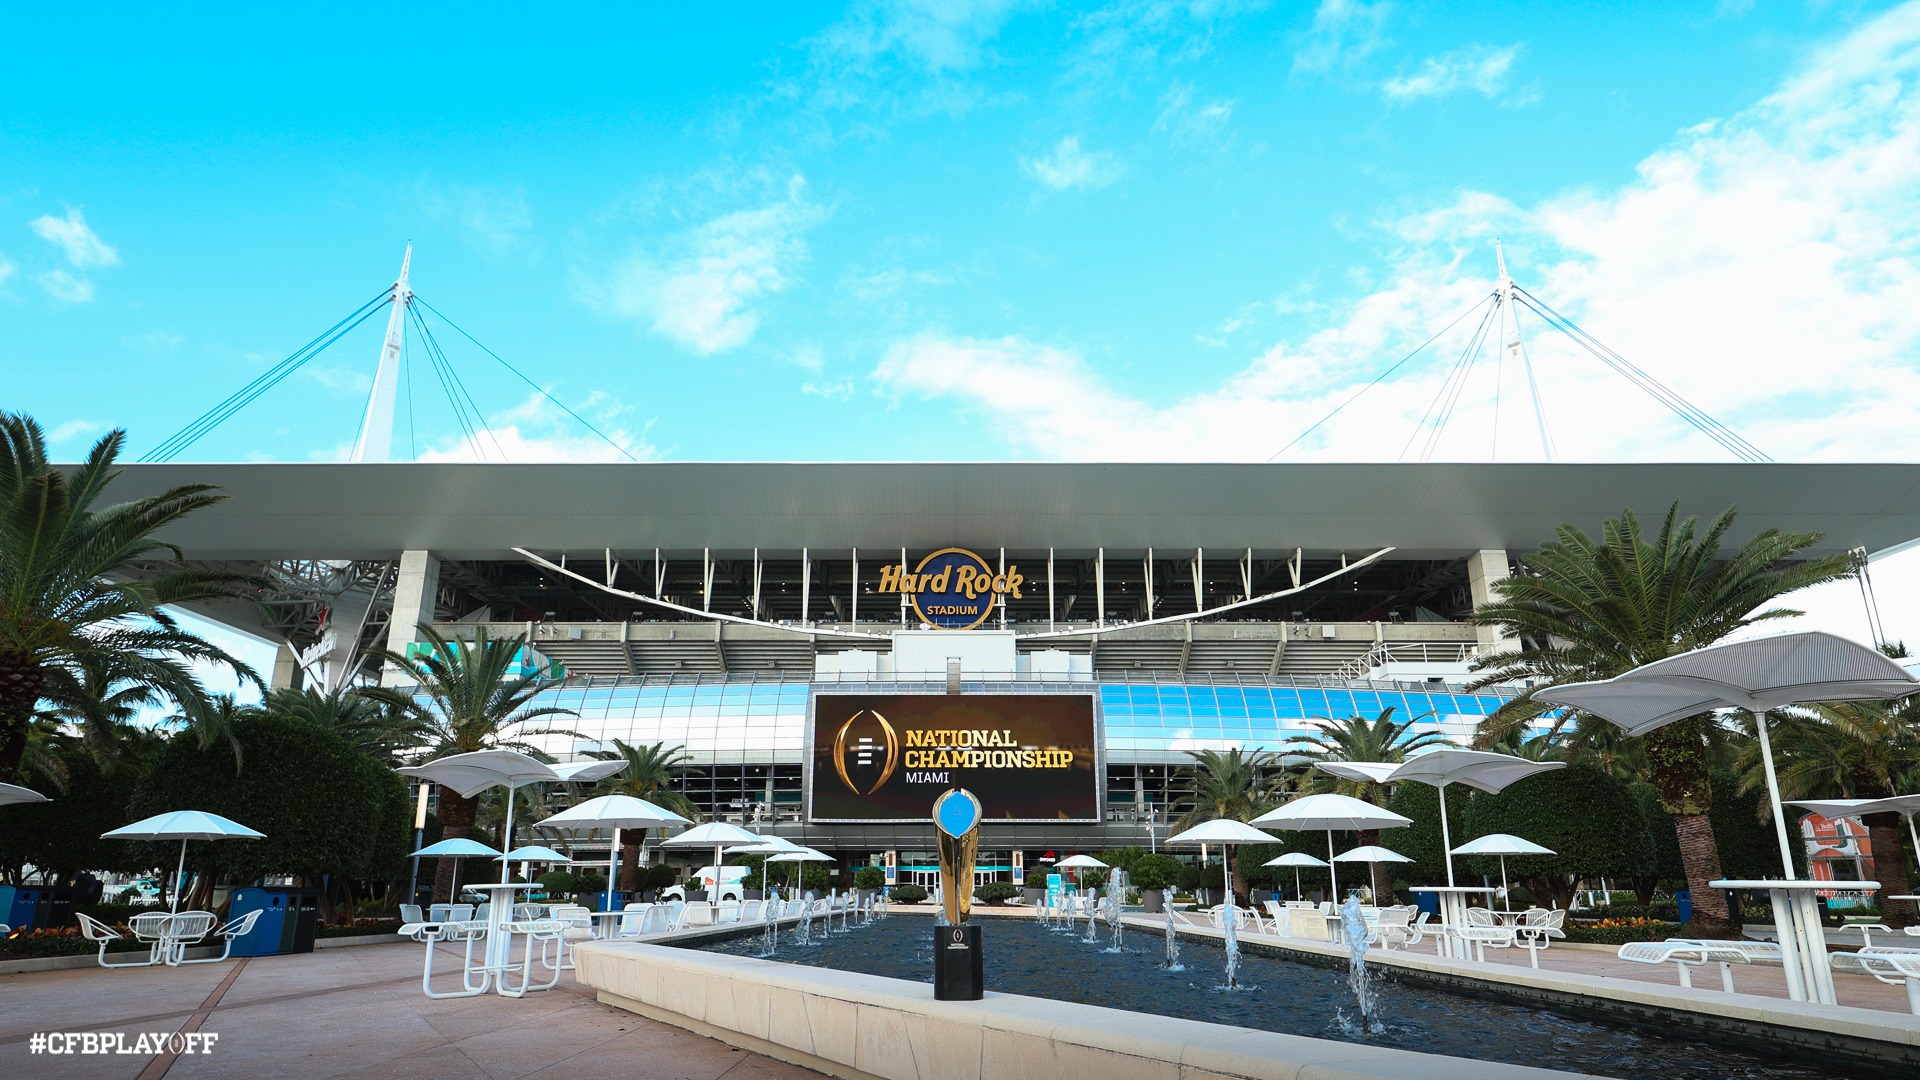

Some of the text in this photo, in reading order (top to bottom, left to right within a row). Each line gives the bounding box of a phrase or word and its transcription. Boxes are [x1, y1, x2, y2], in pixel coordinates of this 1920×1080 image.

[878, 565, 1024, 600] Hard Rock
[927, 605, 978, 615] STADIUM
[905, 729, 1018, 748] NATIONAL
[905, 750, 1074, 769] CHAMPIONSHIP
[906, 771, 950, 784] MIAMI
